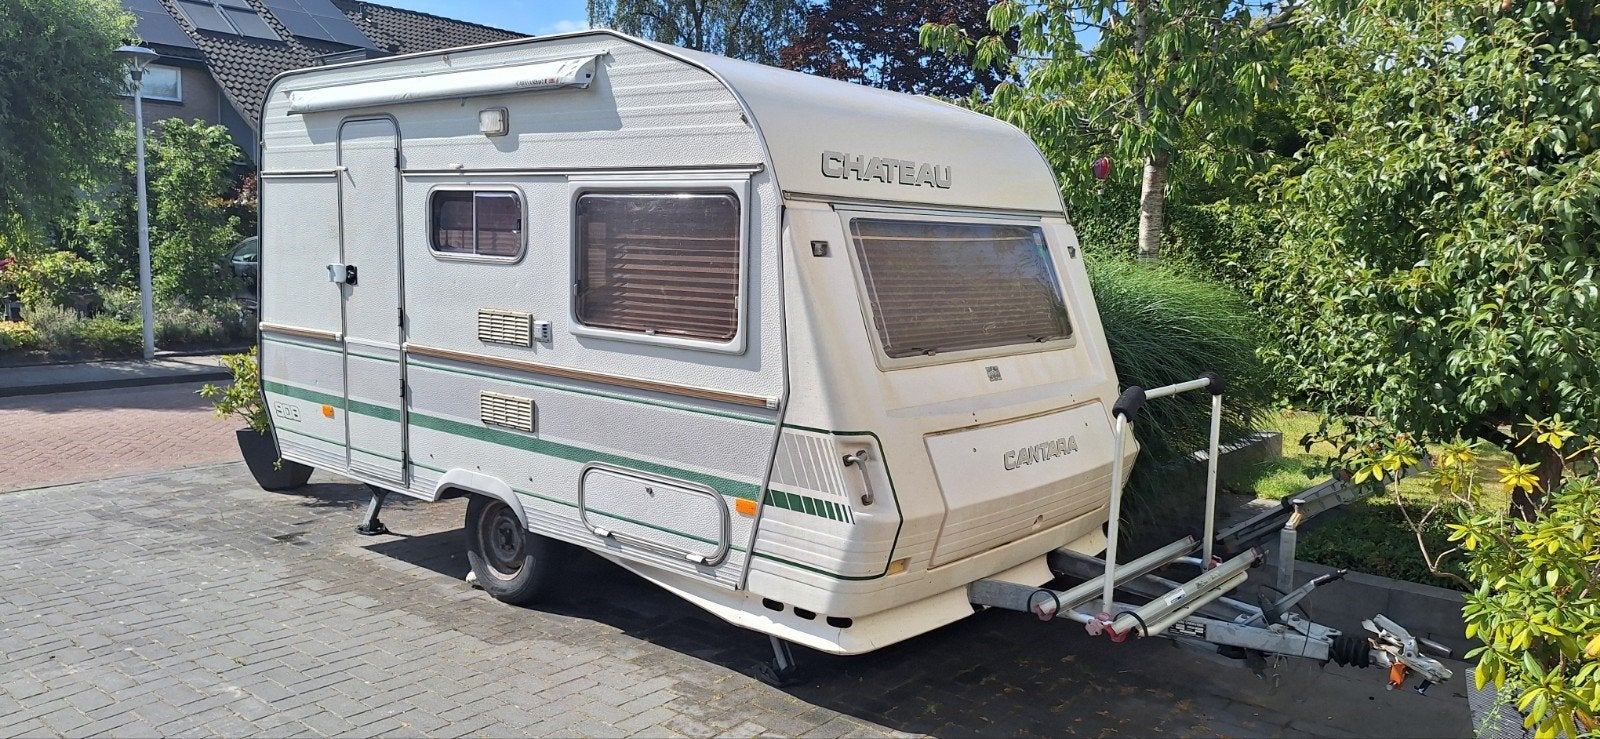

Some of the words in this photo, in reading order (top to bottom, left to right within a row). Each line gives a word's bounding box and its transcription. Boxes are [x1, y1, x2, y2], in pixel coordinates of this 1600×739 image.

[822, 150, 952, 189] CHATEAU
[274, 401, 301, 422] 908
[1004, 435, 1078, 470] CANTARA
